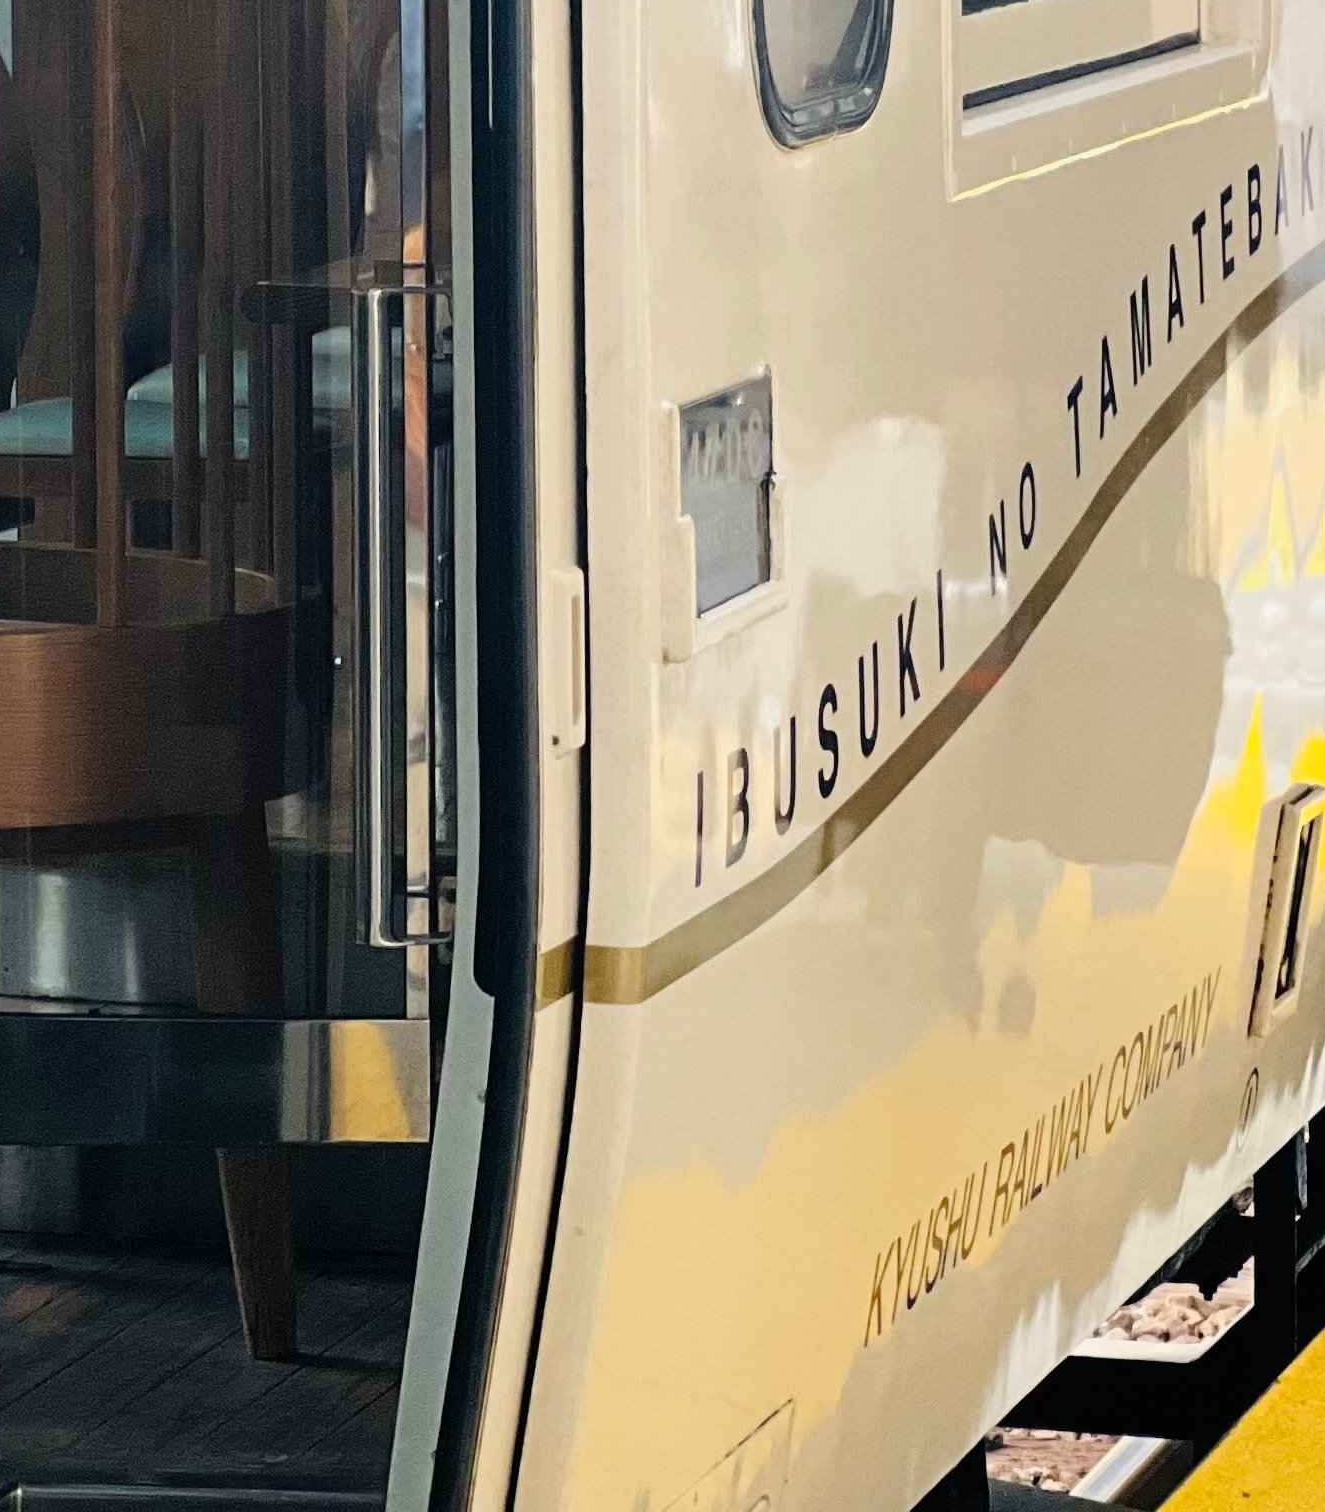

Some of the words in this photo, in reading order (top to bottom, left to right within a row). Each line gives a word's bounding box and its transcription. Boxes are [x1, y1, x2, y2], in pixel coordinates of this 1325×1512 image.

[695, 569, 946, 887] IBUSUKI
[989, 461, 1038, 596] NO
[864, 1161, 987, 1349] KYUSHU
[989, 1063, 1103, 1237] RAILWAY
[1104, 964, 1222, 1135] COMPANY
